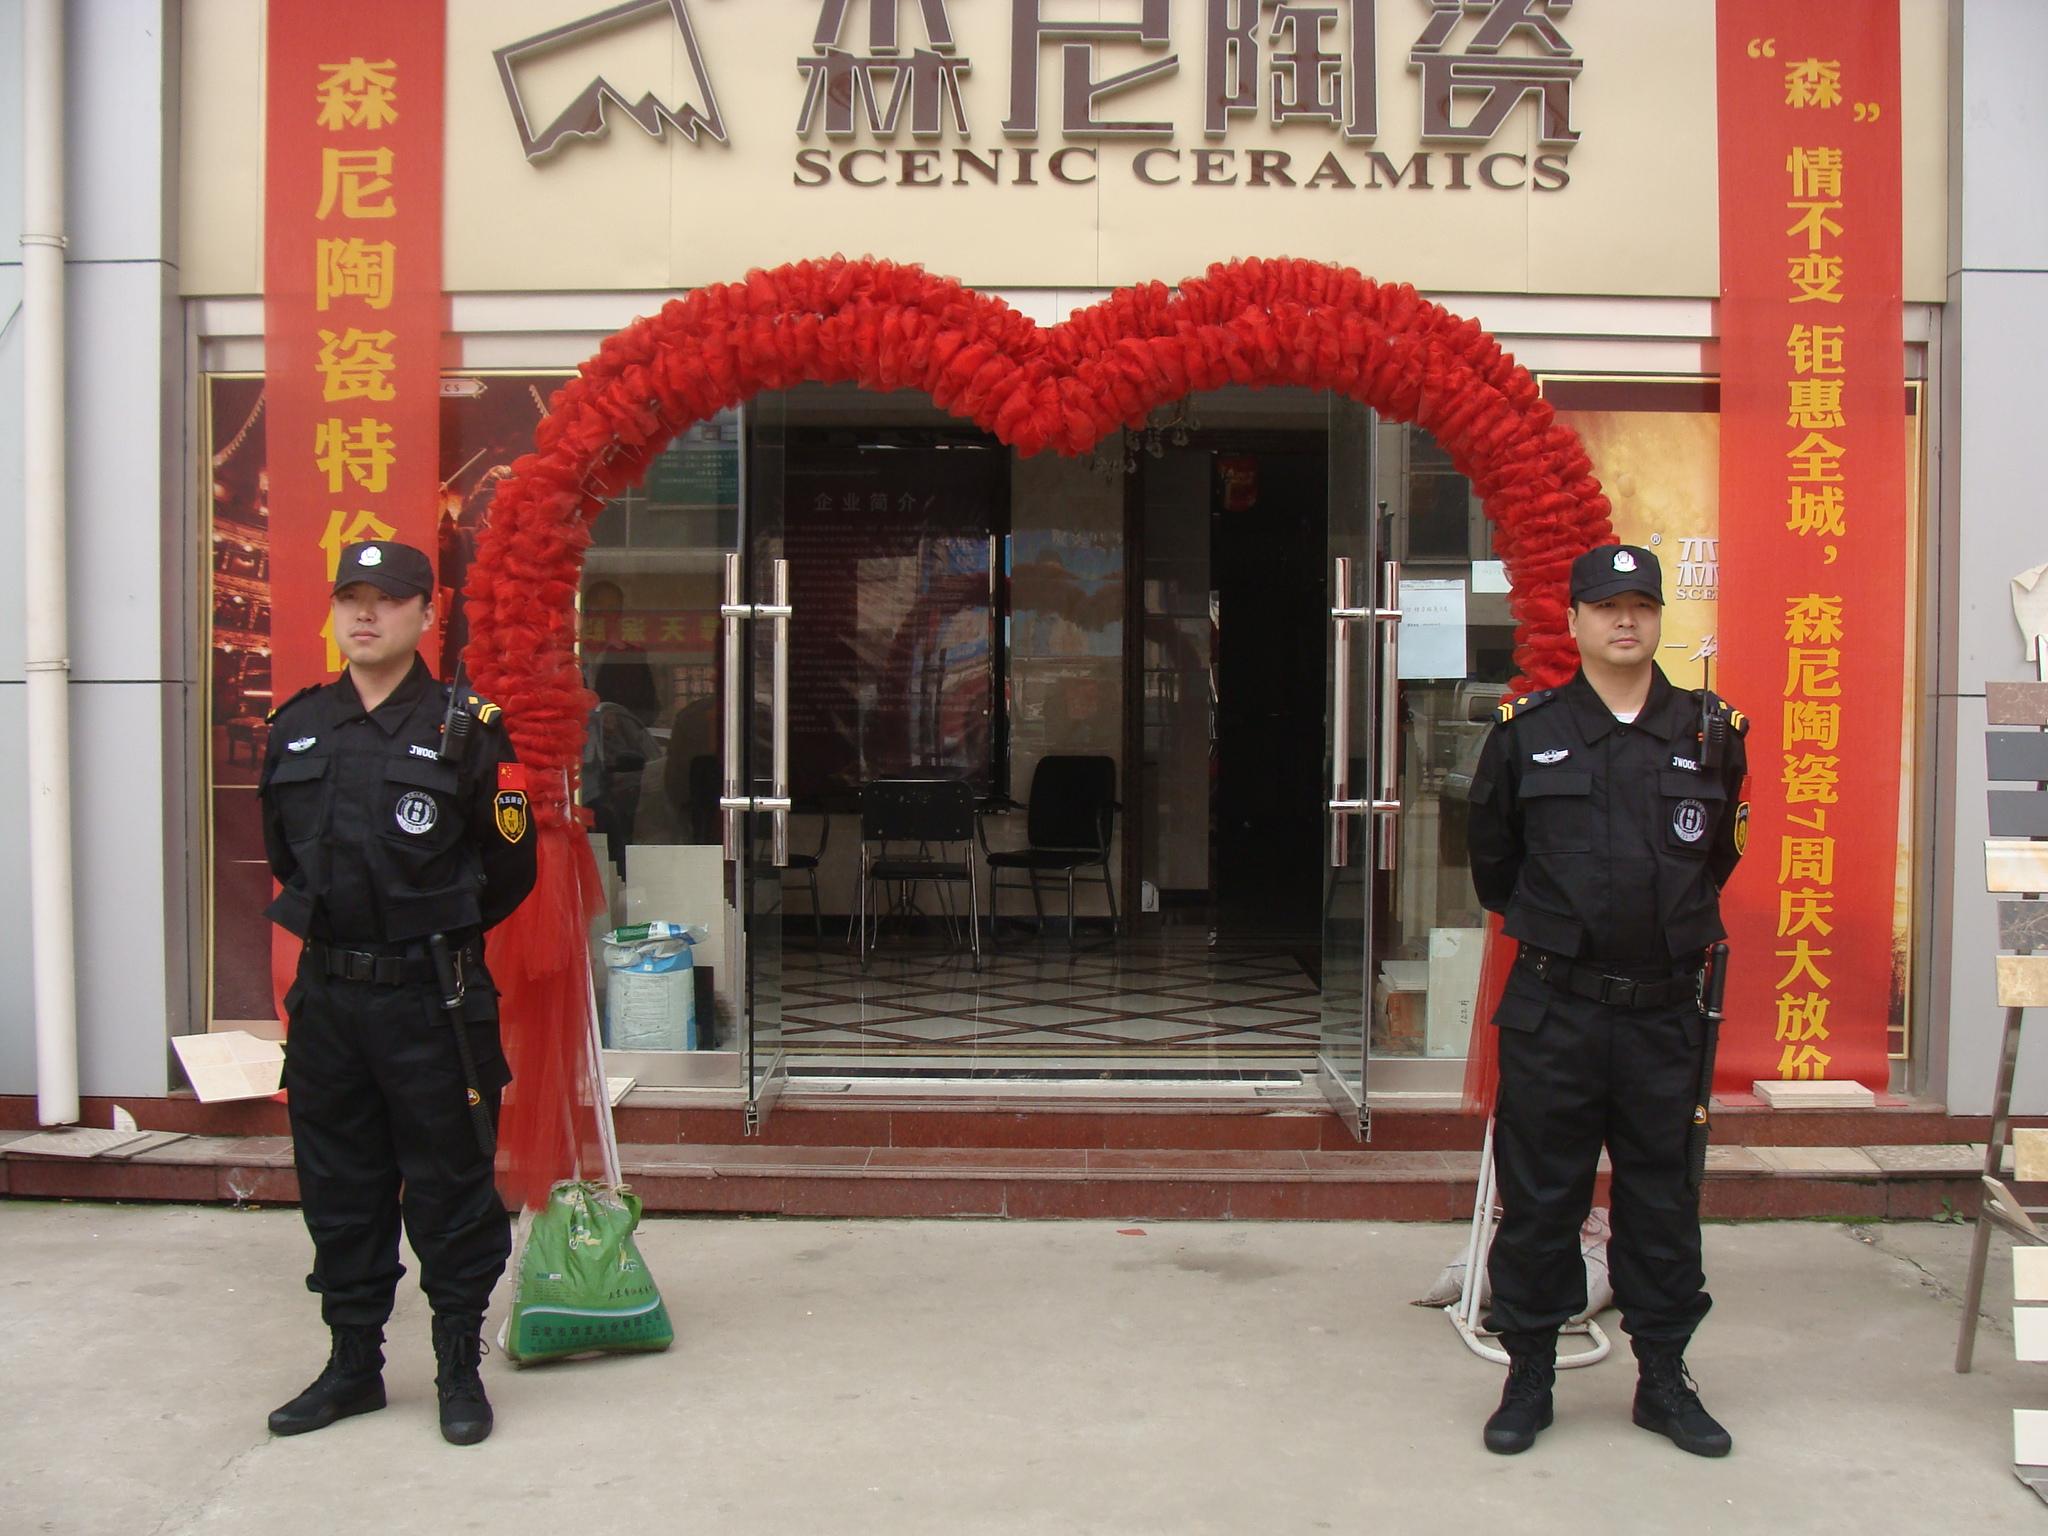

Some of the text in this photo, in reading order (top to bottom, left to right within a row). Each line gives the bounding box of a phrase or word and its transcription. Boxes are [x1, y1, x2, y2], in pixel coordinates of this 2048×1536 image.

[796, 0, 1584, 146] 森尼陶瓷
[793, 147, 1571, 192] SCENIC CERAMICS
[814, 492, 916, 512] 企业简介
[1676, 588, 1719, 601] SCE
